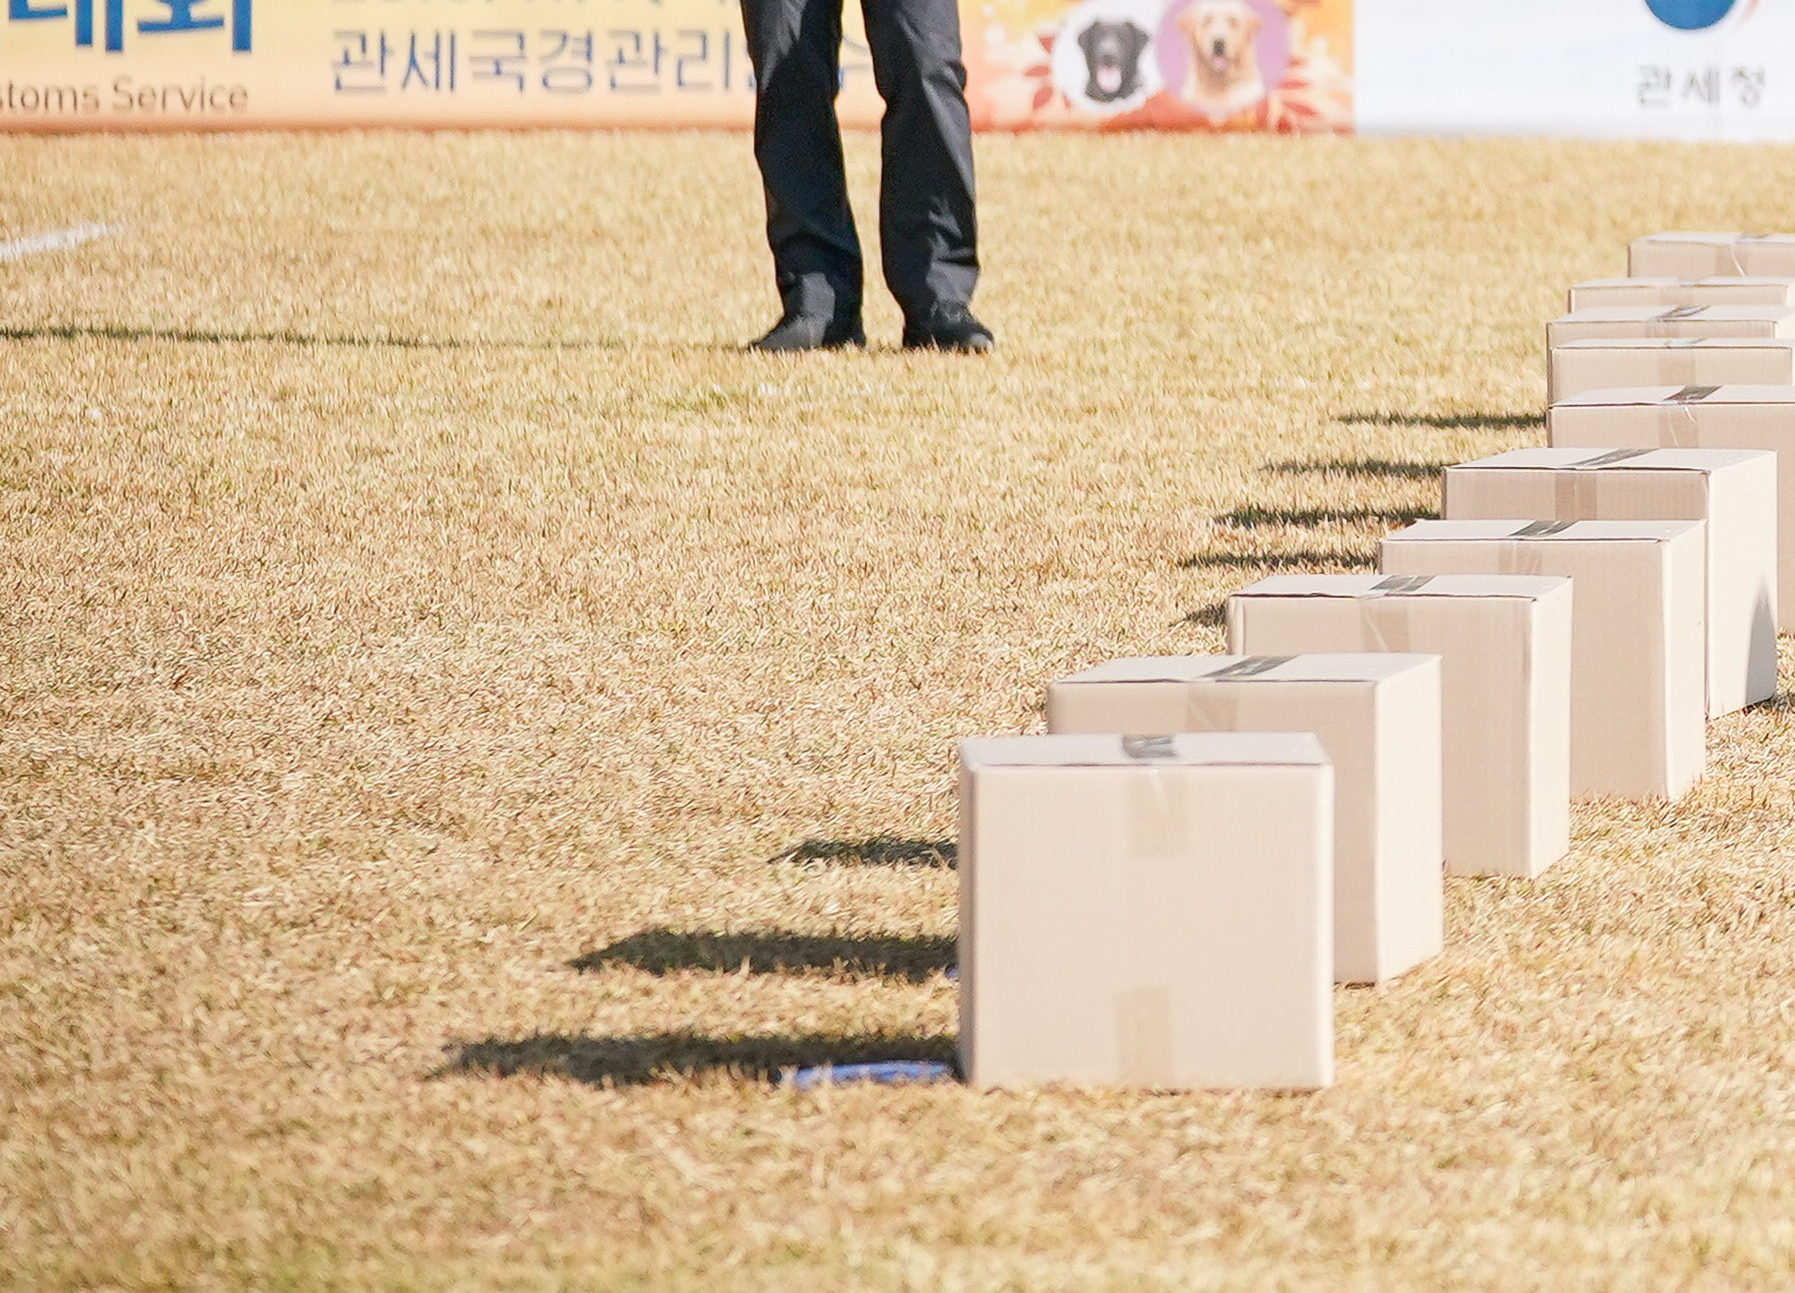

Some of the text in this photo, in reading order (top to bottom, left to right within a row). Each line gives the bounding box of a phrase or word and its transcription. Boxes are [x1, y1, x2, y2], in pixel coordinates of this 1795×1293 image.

[330, 28, 872, 98] 관세국경관리
[1636, 63, 1766, 108] 관세청
[112, 74, 249, 112] Service
